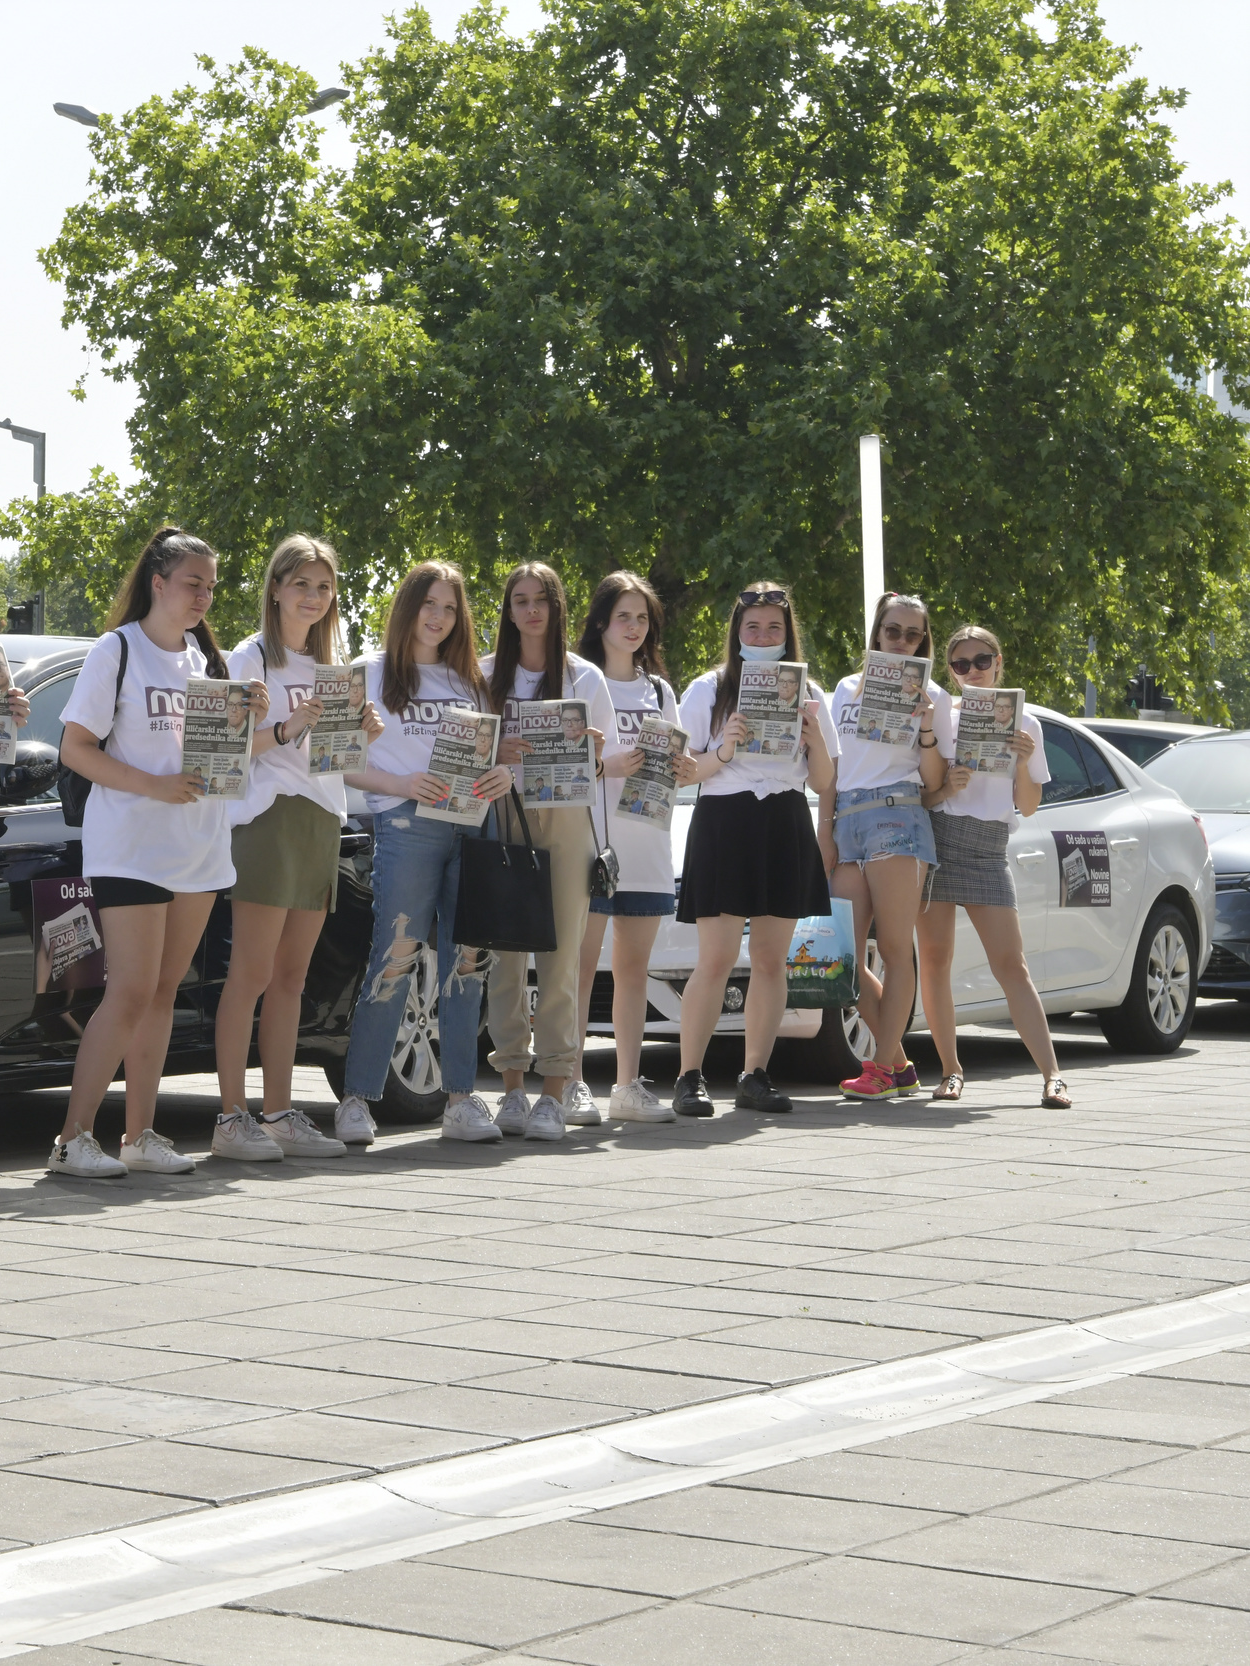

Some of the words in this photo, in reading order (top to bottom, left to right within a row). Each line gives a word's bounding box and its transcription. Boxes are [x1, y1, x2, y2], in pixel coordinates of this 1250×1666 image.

[868, 665, 901, 680] nova
[742, 674, 777, 686] nova
[316, 681, 350, 693] nova
[150, 690, 186, 715] no
[187, 696, 227, 710] nova
[740, 704, 777, 712] predsednika
[961, 699, 993, 711] nova
[522, 716, 560, 728] nova
[185, 724, 216, 734] Uličarski
[403, 725, 437, 736] #Istina
[439, 721, 476, 739] nova
[184, 733, 226, 743] predsednika
[226, 734, 247, 743] države
[639, 731, 669, 748] nova
[434, 746, 463, 758] Uličarski
[432, 754, 472, 767] predsednika
[1066, 833, 1075, 845] Od
[1075, 834, 1087, 845] sada
[1086, 836, 1091, 845] u
[1091, 834, 1107, 845] vašim
[1088, 846, 1108, 857] rukama
[1090, 868, 1110, 880] Novine
[61, 883, 75, 899] Od
[1092, 883, 1109, 894] nova
